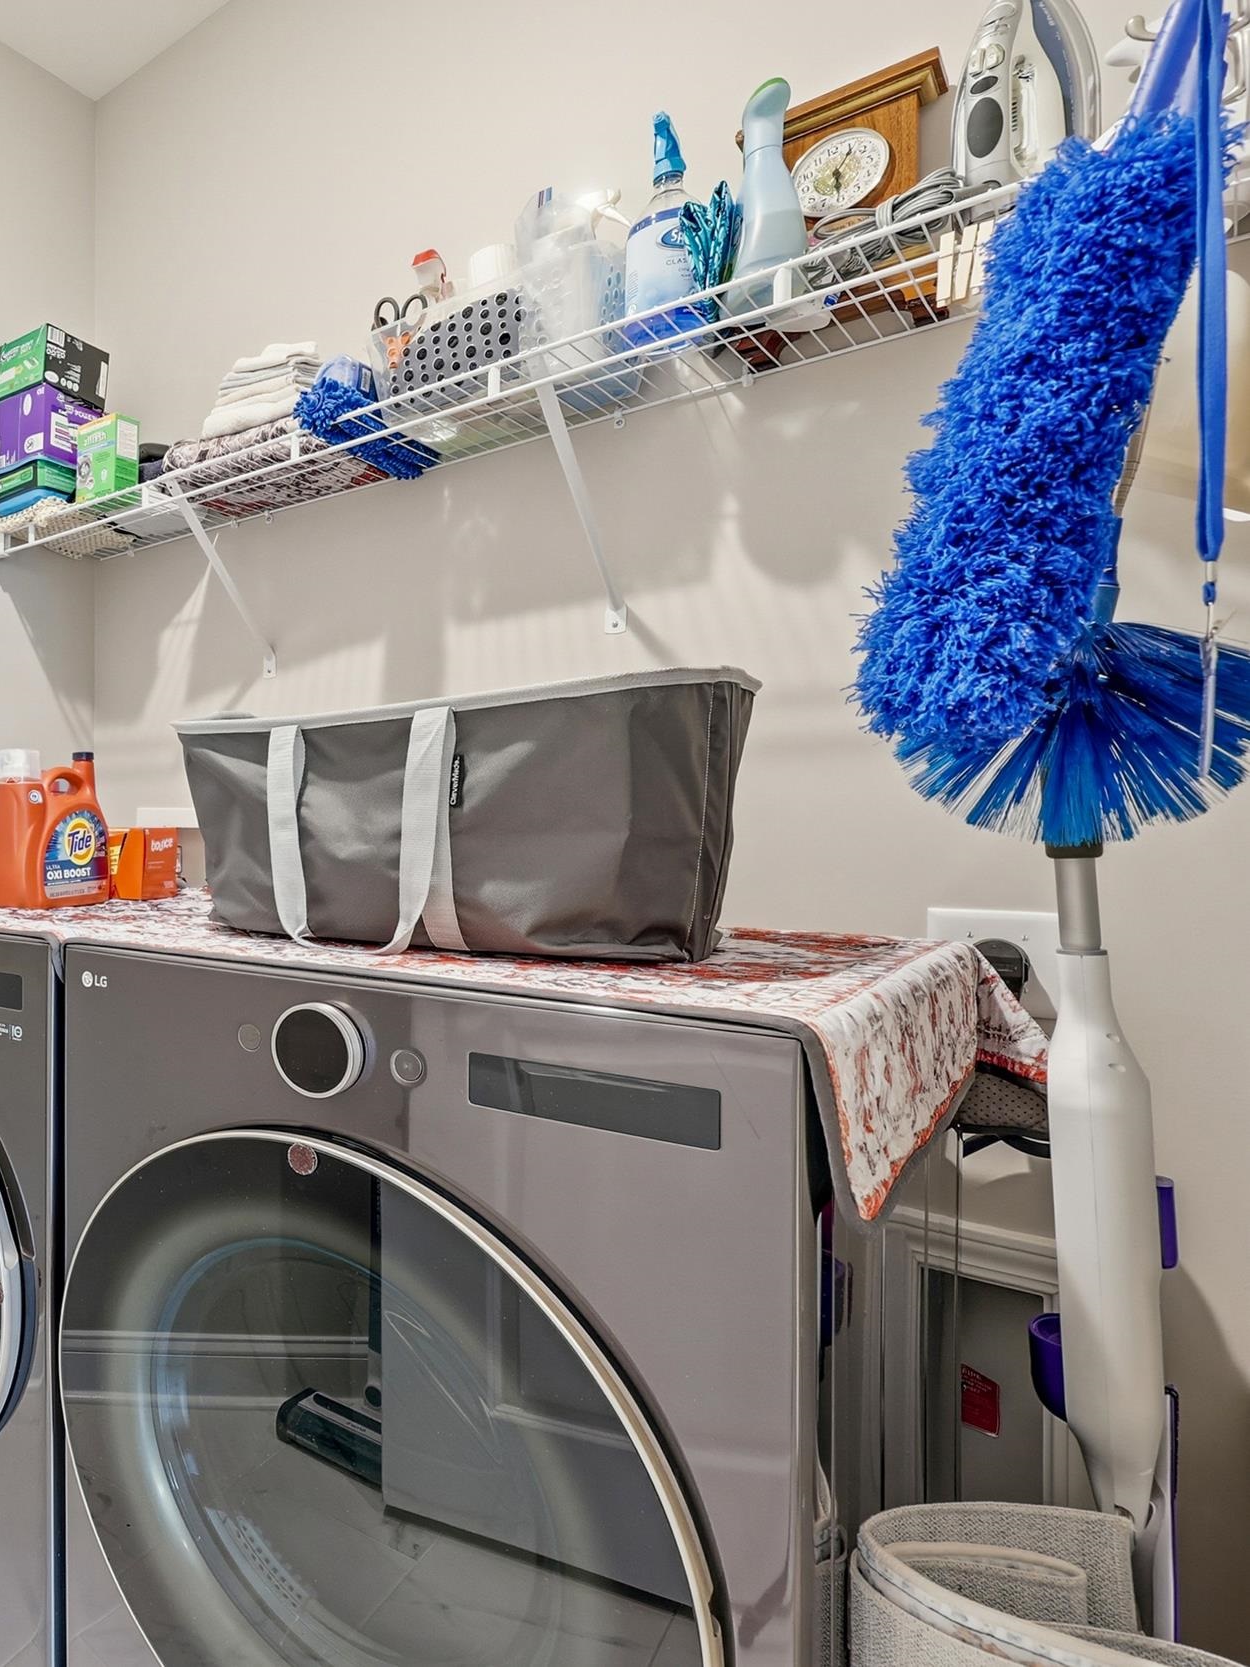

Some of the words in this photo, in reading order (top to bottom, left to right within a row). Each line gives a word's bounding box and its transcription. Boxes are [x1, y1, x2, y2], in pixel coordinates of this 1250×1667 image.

[827, 146, 839, 157] 12
[665, 258, 688, 266] CLAS
[68, 829, 92, 857] Tide
[46, 870, 63, 880] OXI
[63, 867, 91, 879] BOOST
[94, 974, 108, 988] LG
